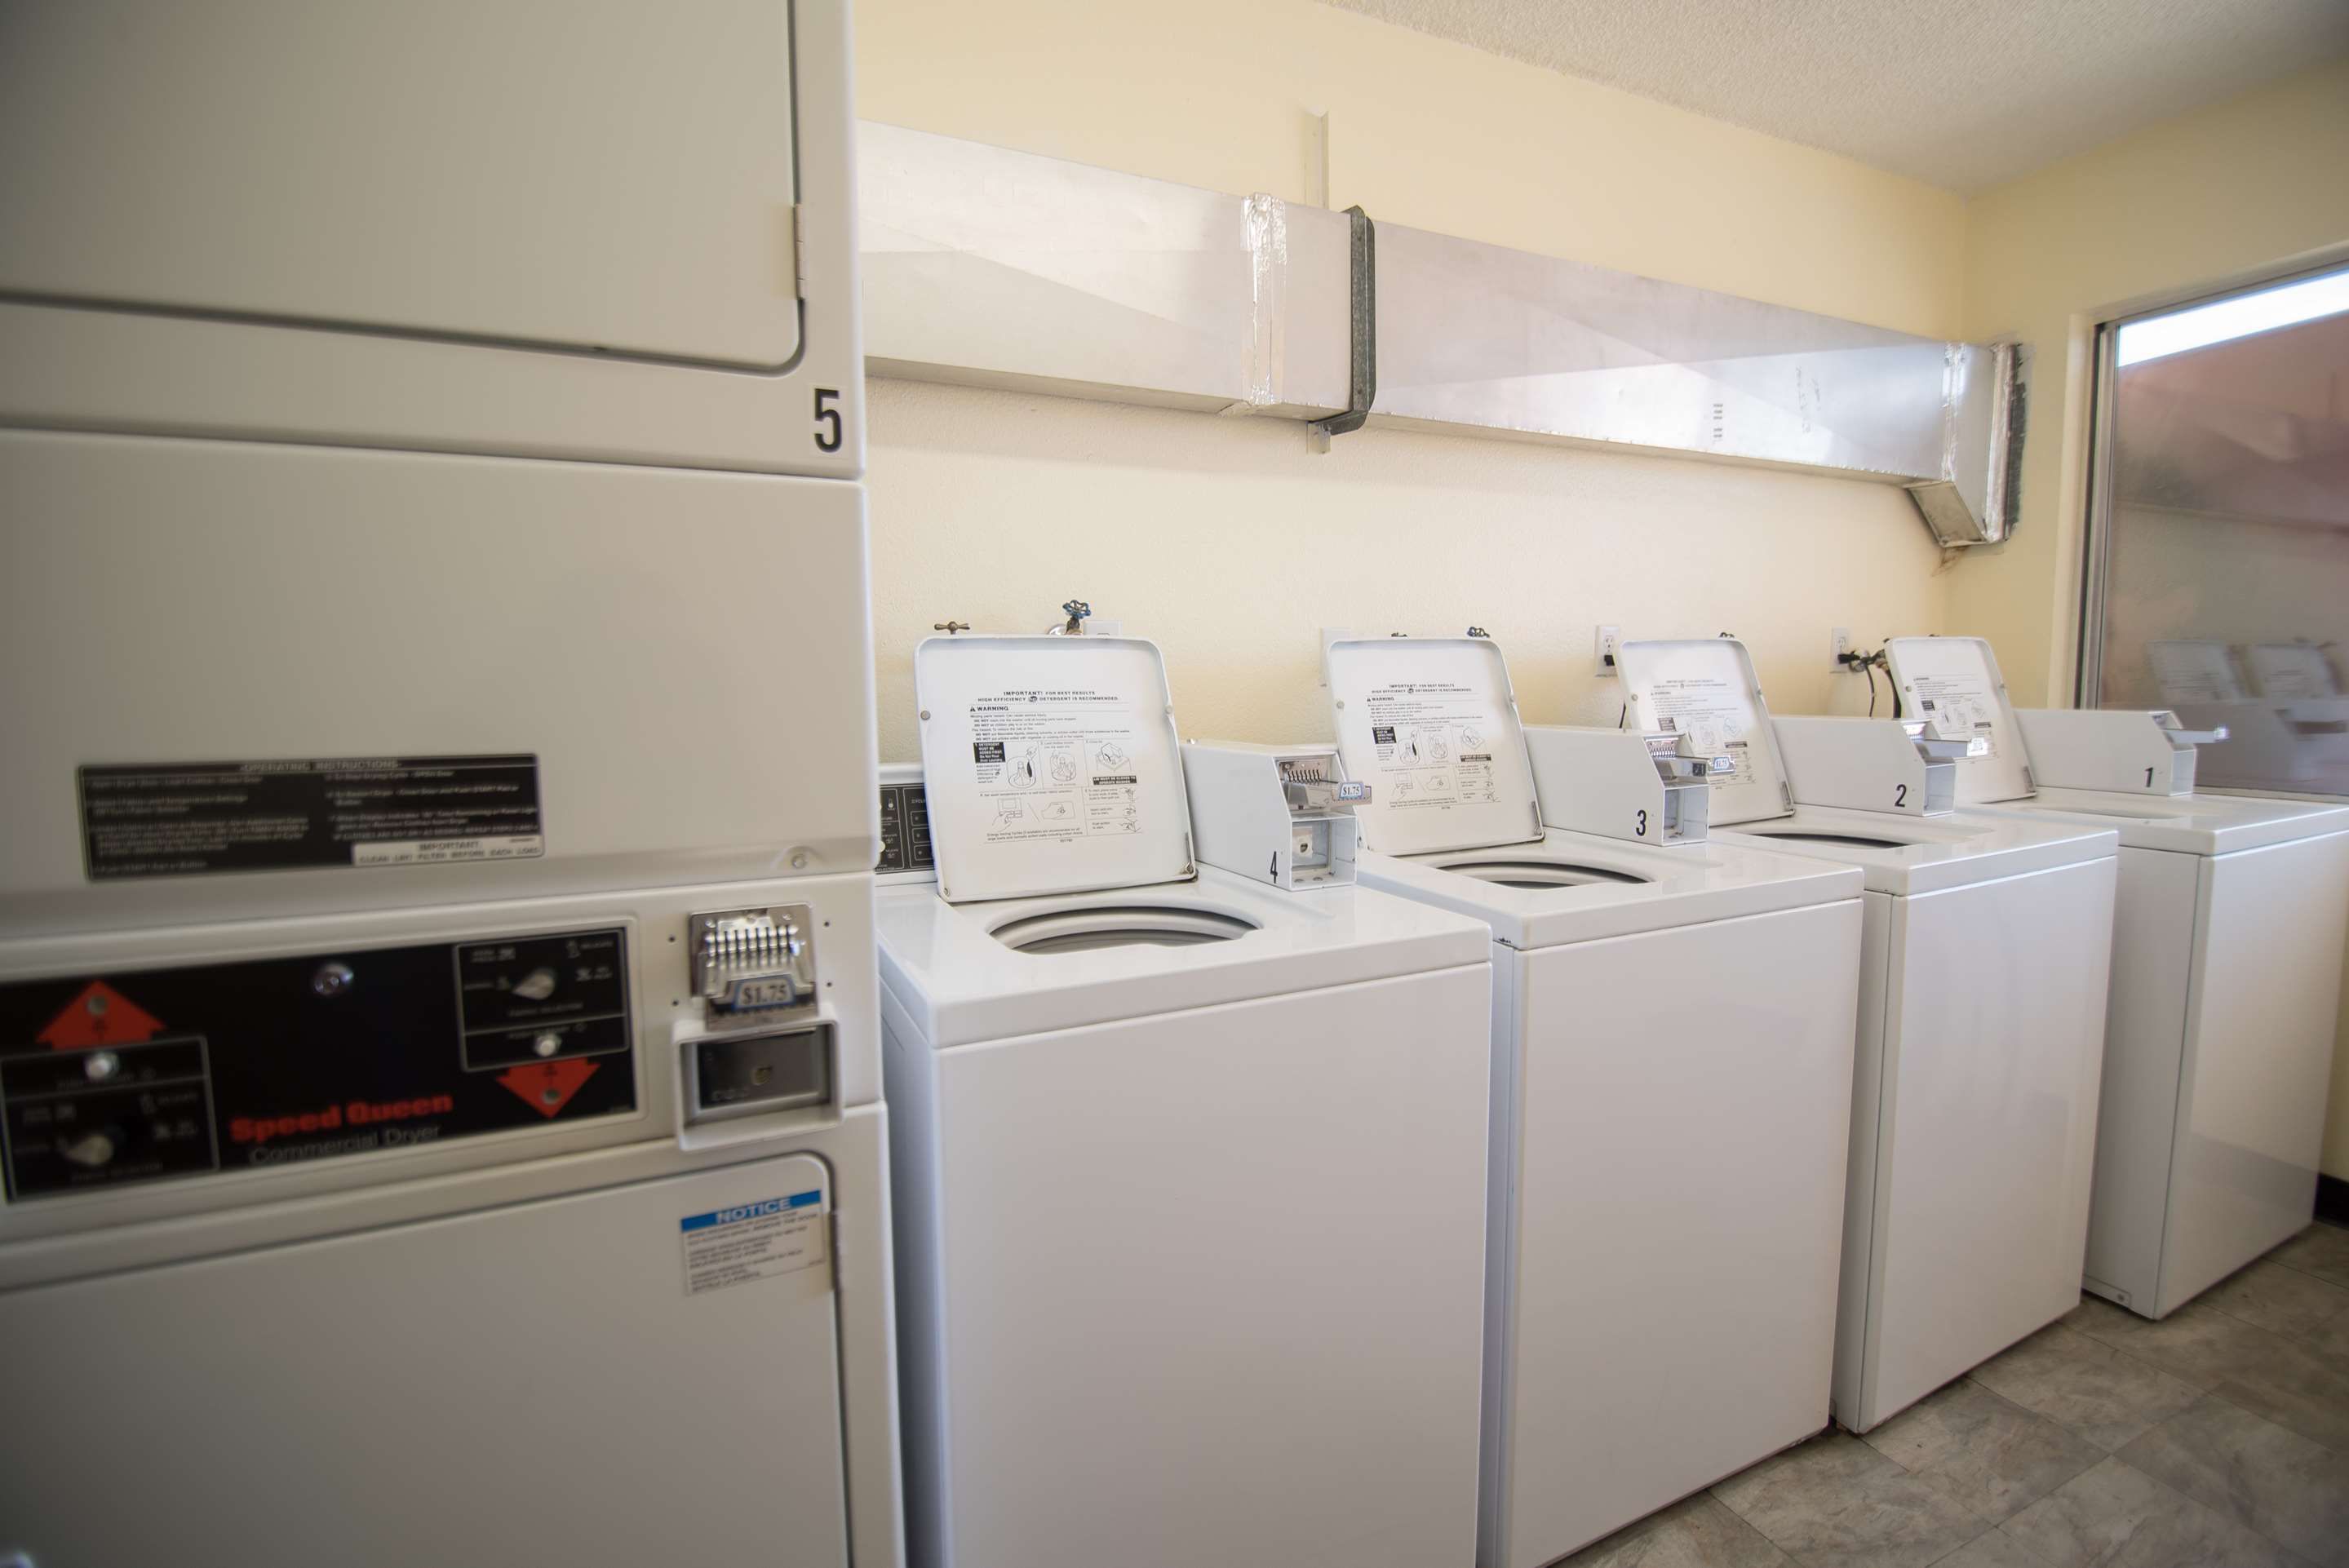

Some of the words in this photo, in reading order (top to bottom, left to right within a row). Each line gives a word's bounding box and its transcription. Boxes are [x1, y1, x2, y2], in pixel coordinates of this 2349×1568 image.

[813, 388, 842, 453] 5
[2144, 767, 2154, 787] 1
[1342, 786, 1360, 796] $1.75
[1894, 784, 1908, 807] 2
[1635, 809, 1647, 836] 3
[1270, 851, 1278, 884] 4
[742, 984, 787, 1004] $1.75
[230, 1104, 342, 1143] Speed
[346, 1094, 454, 1125] Queen
[249, 1132, 379, 1163] Commercial
[384, 1125, 441, 1145] Dryer
[716, 1198, 791, 1225] NOTICE
